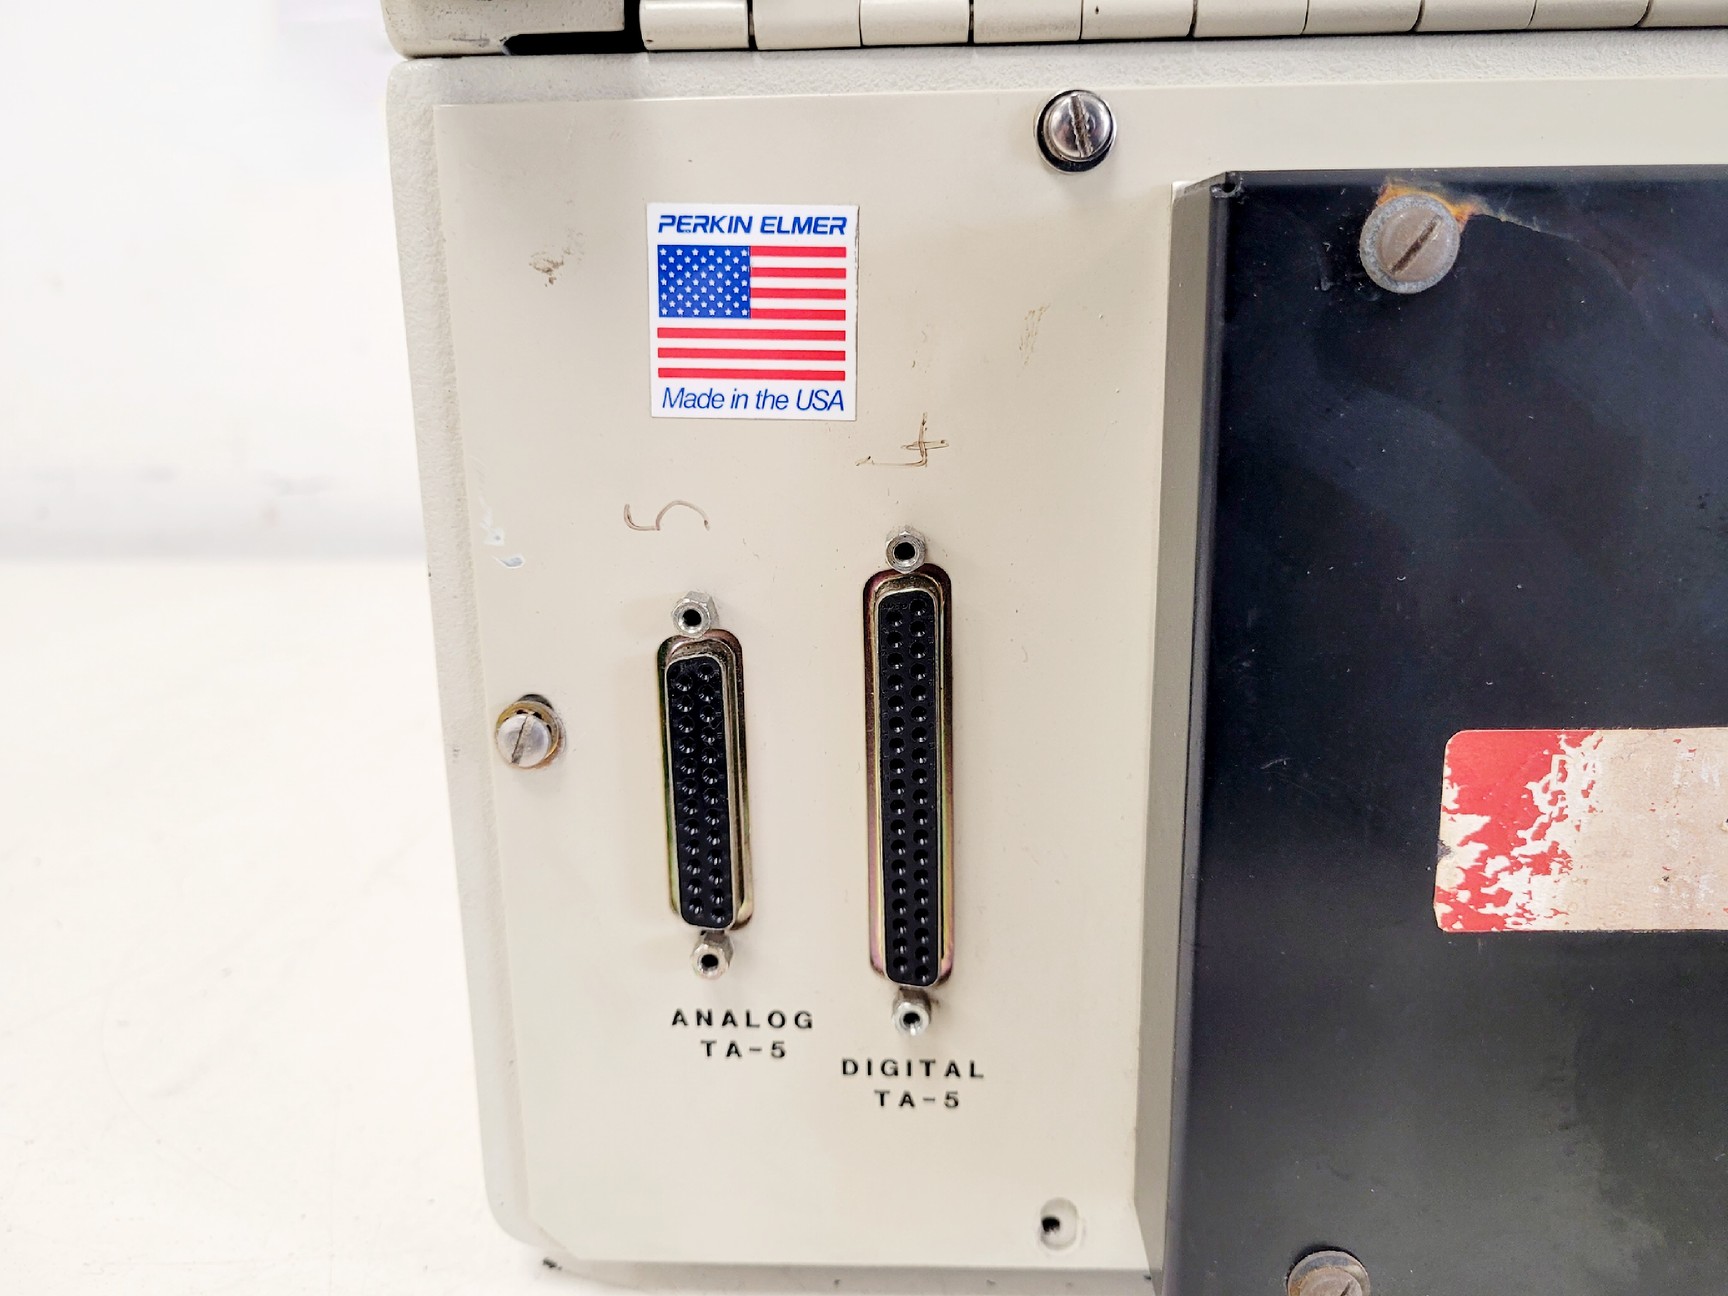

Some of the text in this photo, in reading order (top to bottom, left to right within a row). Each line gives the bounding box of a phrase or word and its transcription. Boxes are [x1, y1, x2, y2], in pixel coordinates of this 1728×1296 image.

[658, 214, 848, 235] PERKIN ELMER
[662, 387, 845, 412] Made in the USA
[671, 1008, 814, 1029] ANALOG
[700, 1040, 787, 1059] TA-5
[841, 1058, 984, 1079] DIGITAL
[873, 1089, 960, 1108] TA-5
